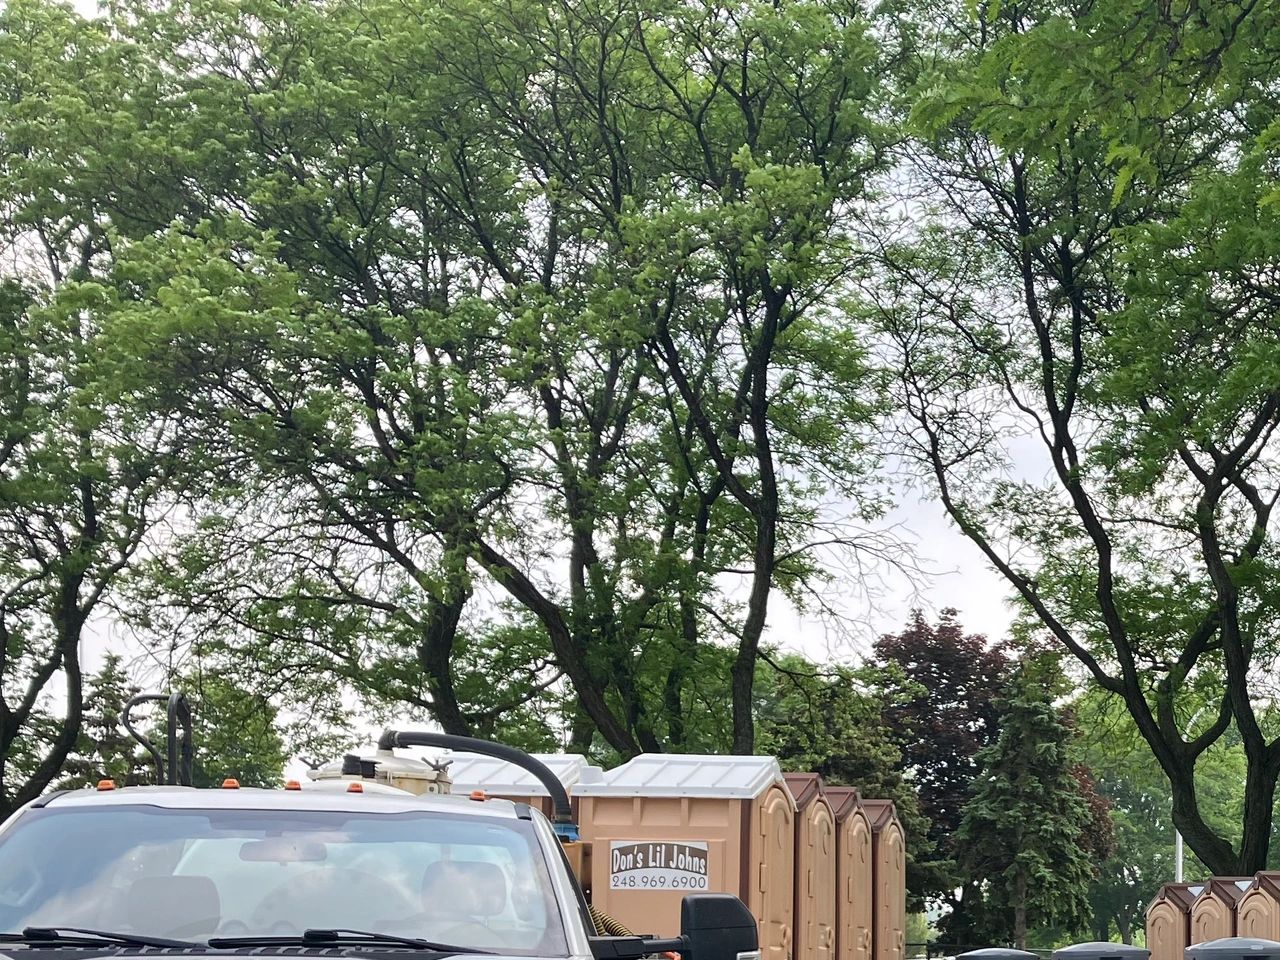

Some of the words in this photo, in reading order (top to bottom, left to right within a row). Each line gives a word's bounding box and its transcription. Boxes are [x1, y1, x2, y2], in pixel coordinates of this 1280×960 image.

[613, 845, 643, 872] Don's
[648, 844, 665, 867] Lil
[670, 845, 705, 874] Johns
[612, 876, 706, 888] 248.969.6900
